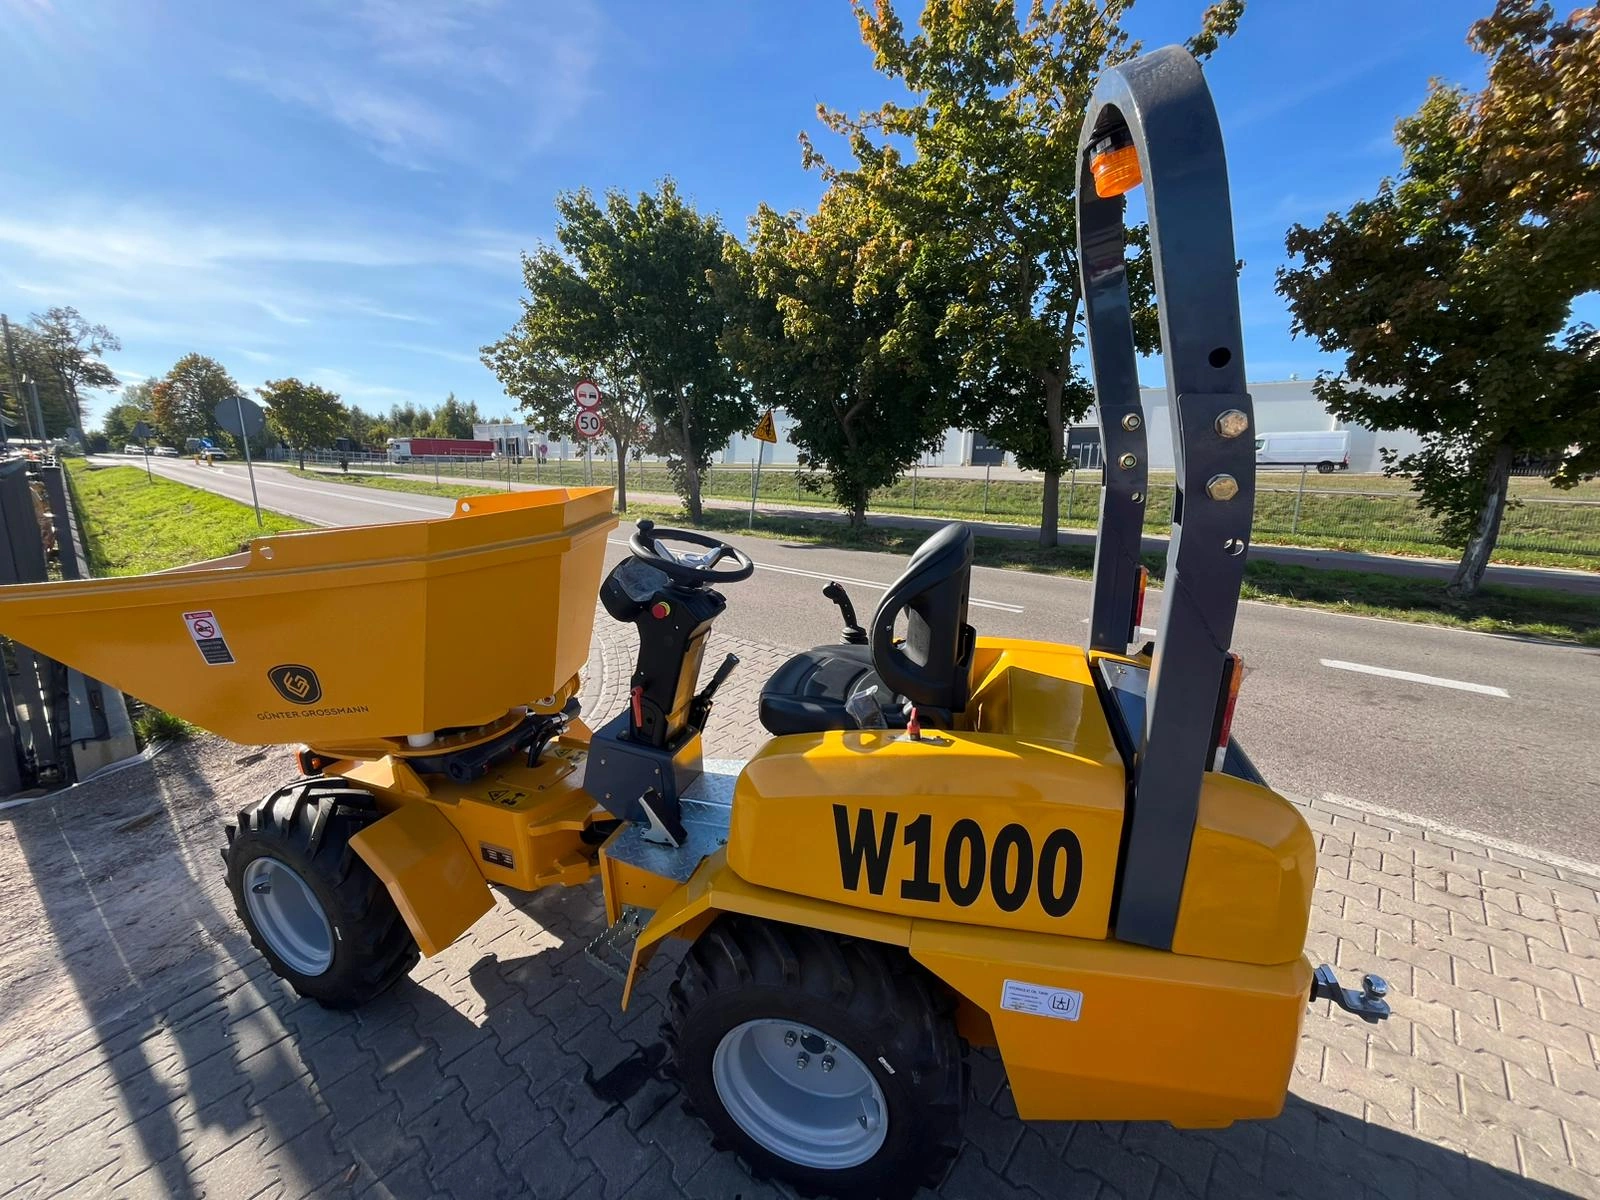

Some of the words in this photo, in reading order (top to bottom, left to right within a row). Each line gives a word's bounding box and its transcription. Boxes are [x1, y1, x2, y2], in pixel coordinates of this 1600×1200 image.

[580, 416, 599, 430] 50
[301, 705, 369, 717] GROSSMANN
[832, 803, 1083, 918] W1000
